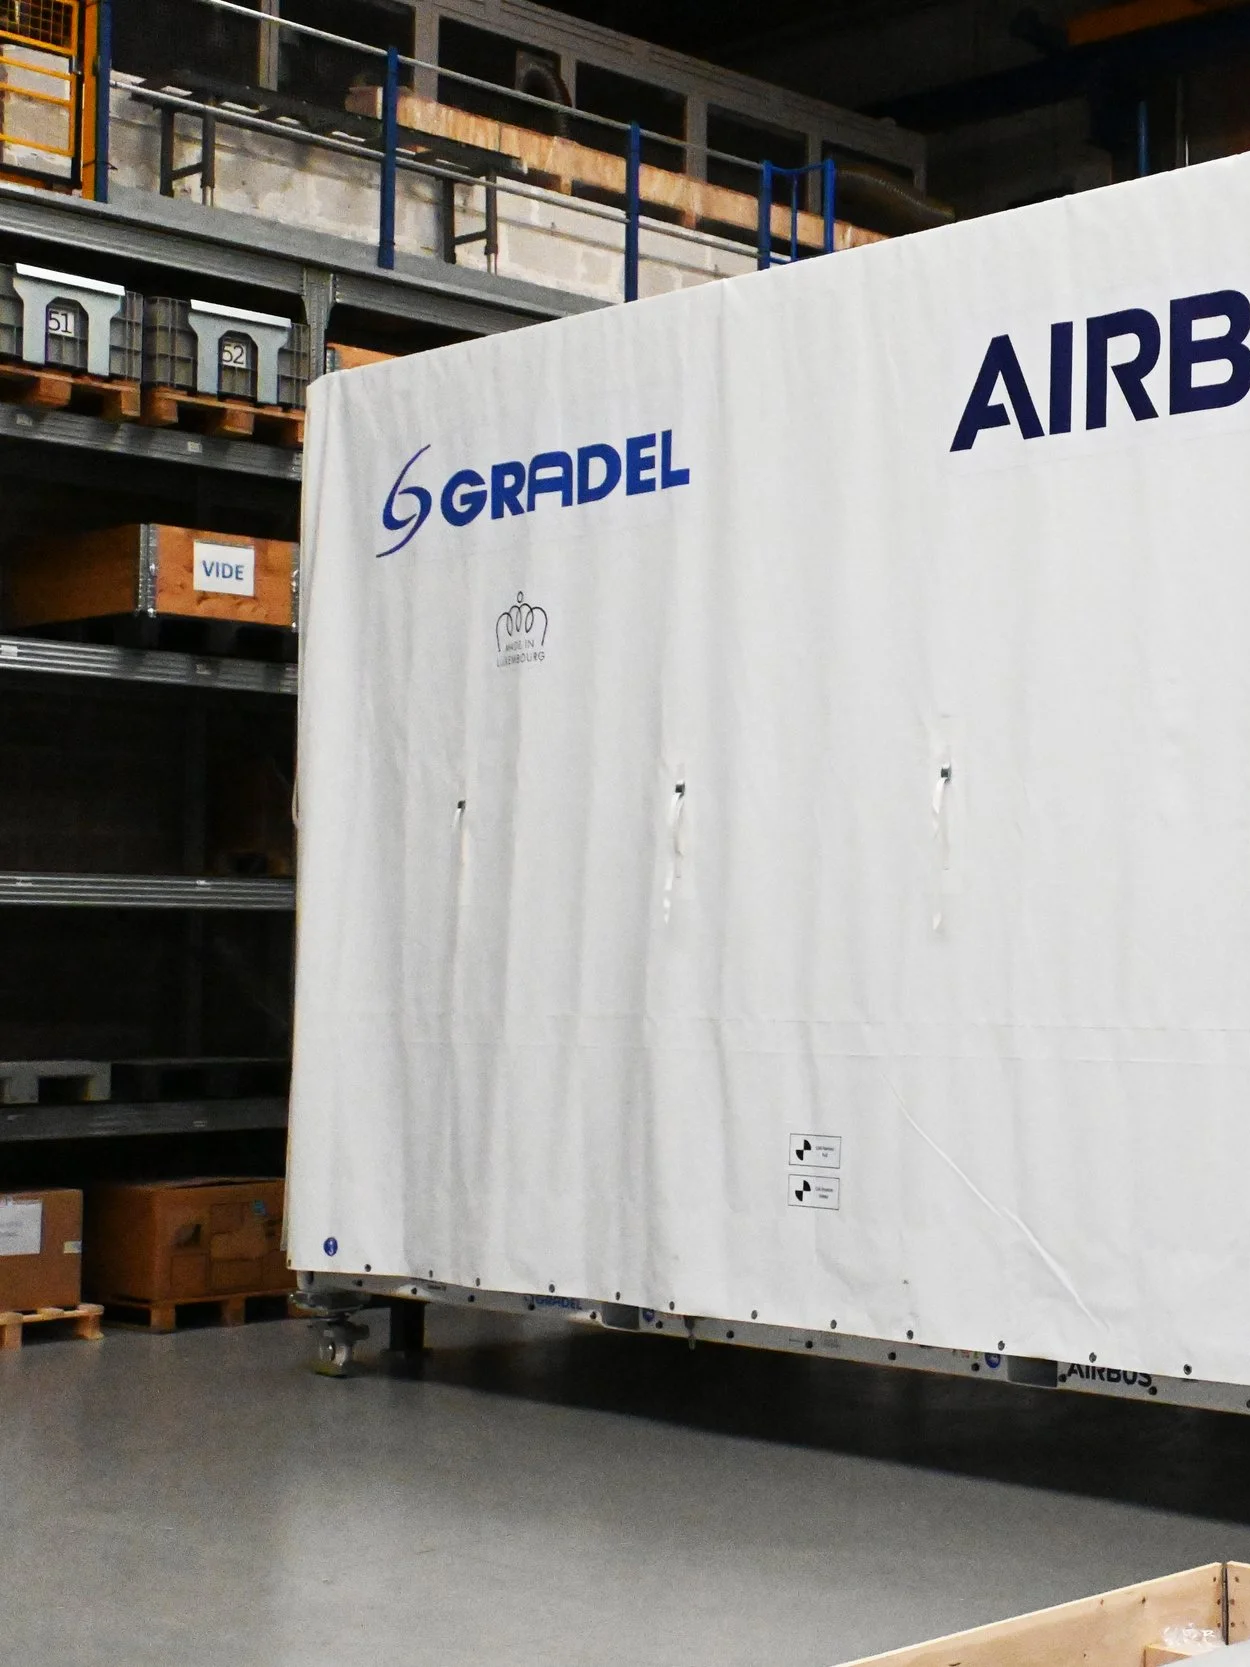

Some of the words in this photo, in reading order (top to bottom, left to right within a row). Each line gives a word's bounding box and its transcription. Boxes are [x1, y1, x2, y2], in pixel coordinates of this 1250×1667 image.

[48, 311, 72, 334] 51
[222, 344, 245, 365] 52
[440, 429, 690, 527] GRADEL
[202, 560, 244, 580] VIDE
[525, 639, 535, 649] IN
[1067, 1362, 1152, 1388] AIRBUS
